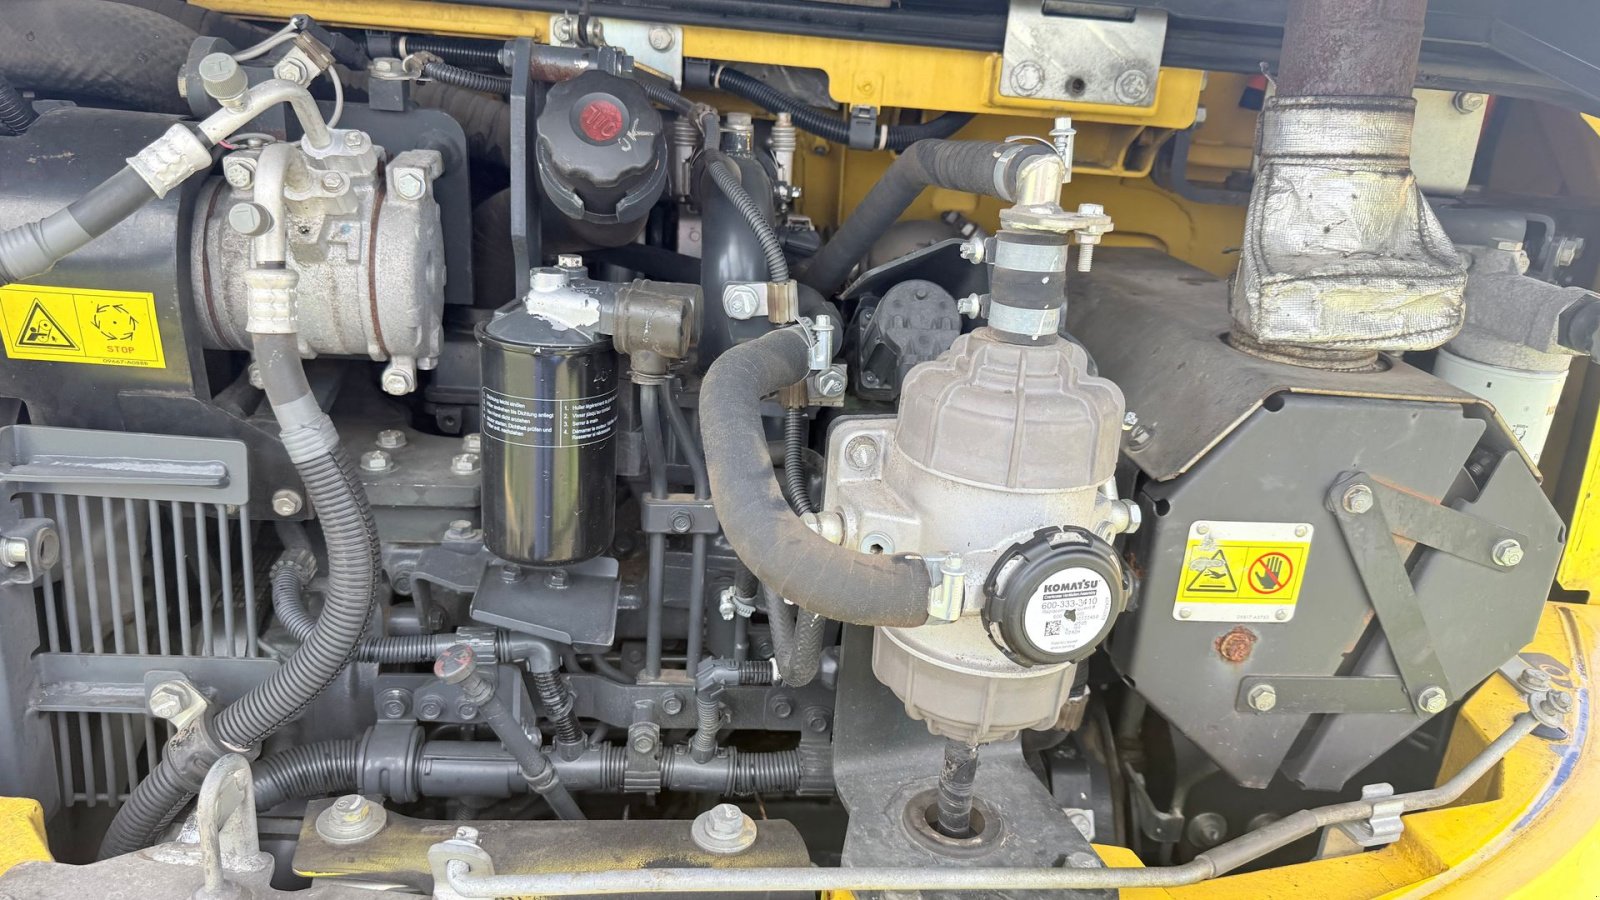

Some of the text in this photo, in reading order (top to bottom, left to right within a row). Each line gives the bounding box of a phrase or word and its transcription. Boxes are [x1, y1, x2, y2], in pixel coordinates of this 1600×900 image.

[586, 104, 617, 138] OIL
[106, 345, 135, 354] STOP
[1043, 579, 1099, 593] KOMATSU
